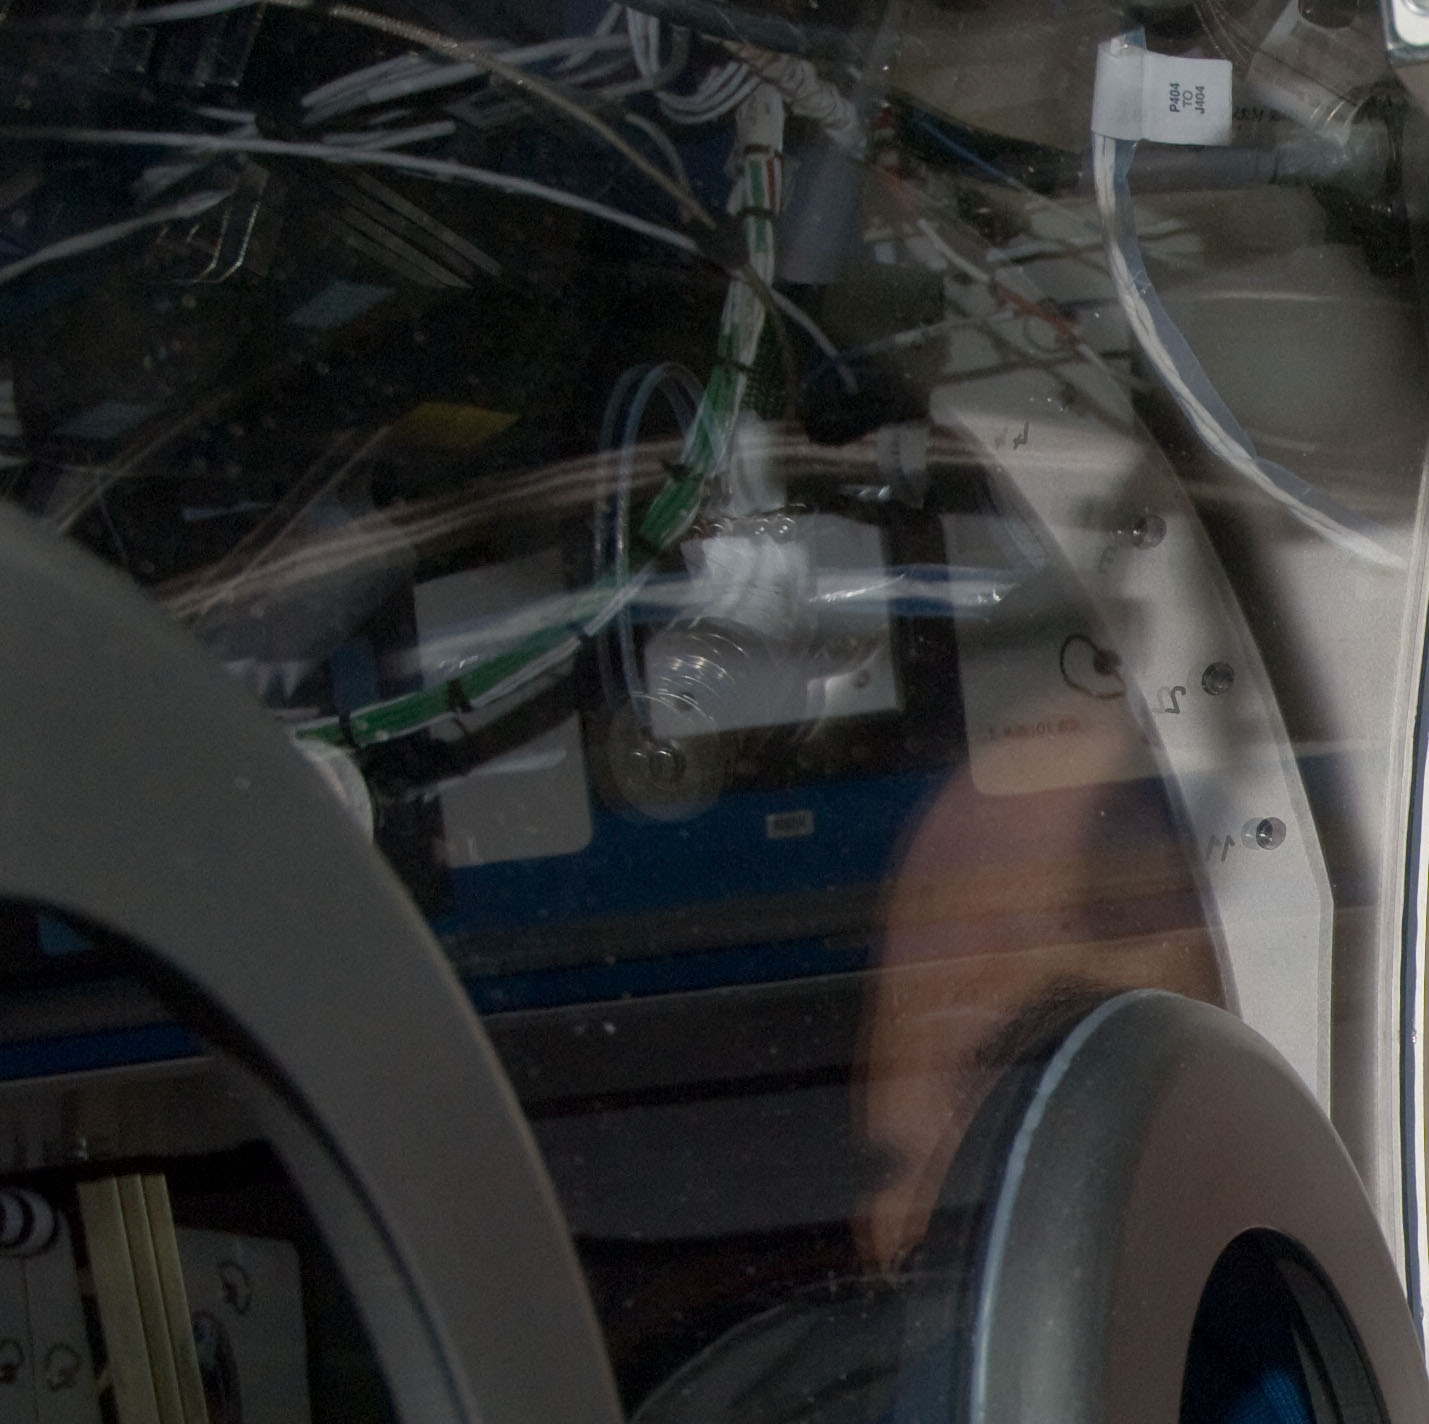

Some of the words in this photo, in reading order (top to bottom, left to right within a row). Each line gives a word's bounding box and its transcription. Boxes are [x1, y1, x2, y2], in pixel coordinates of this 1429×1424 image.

[1169, 83, 1181, 113] P404
[1182, 90, 1194, 109] TO
[1195, 86, 1206, 114] J404
